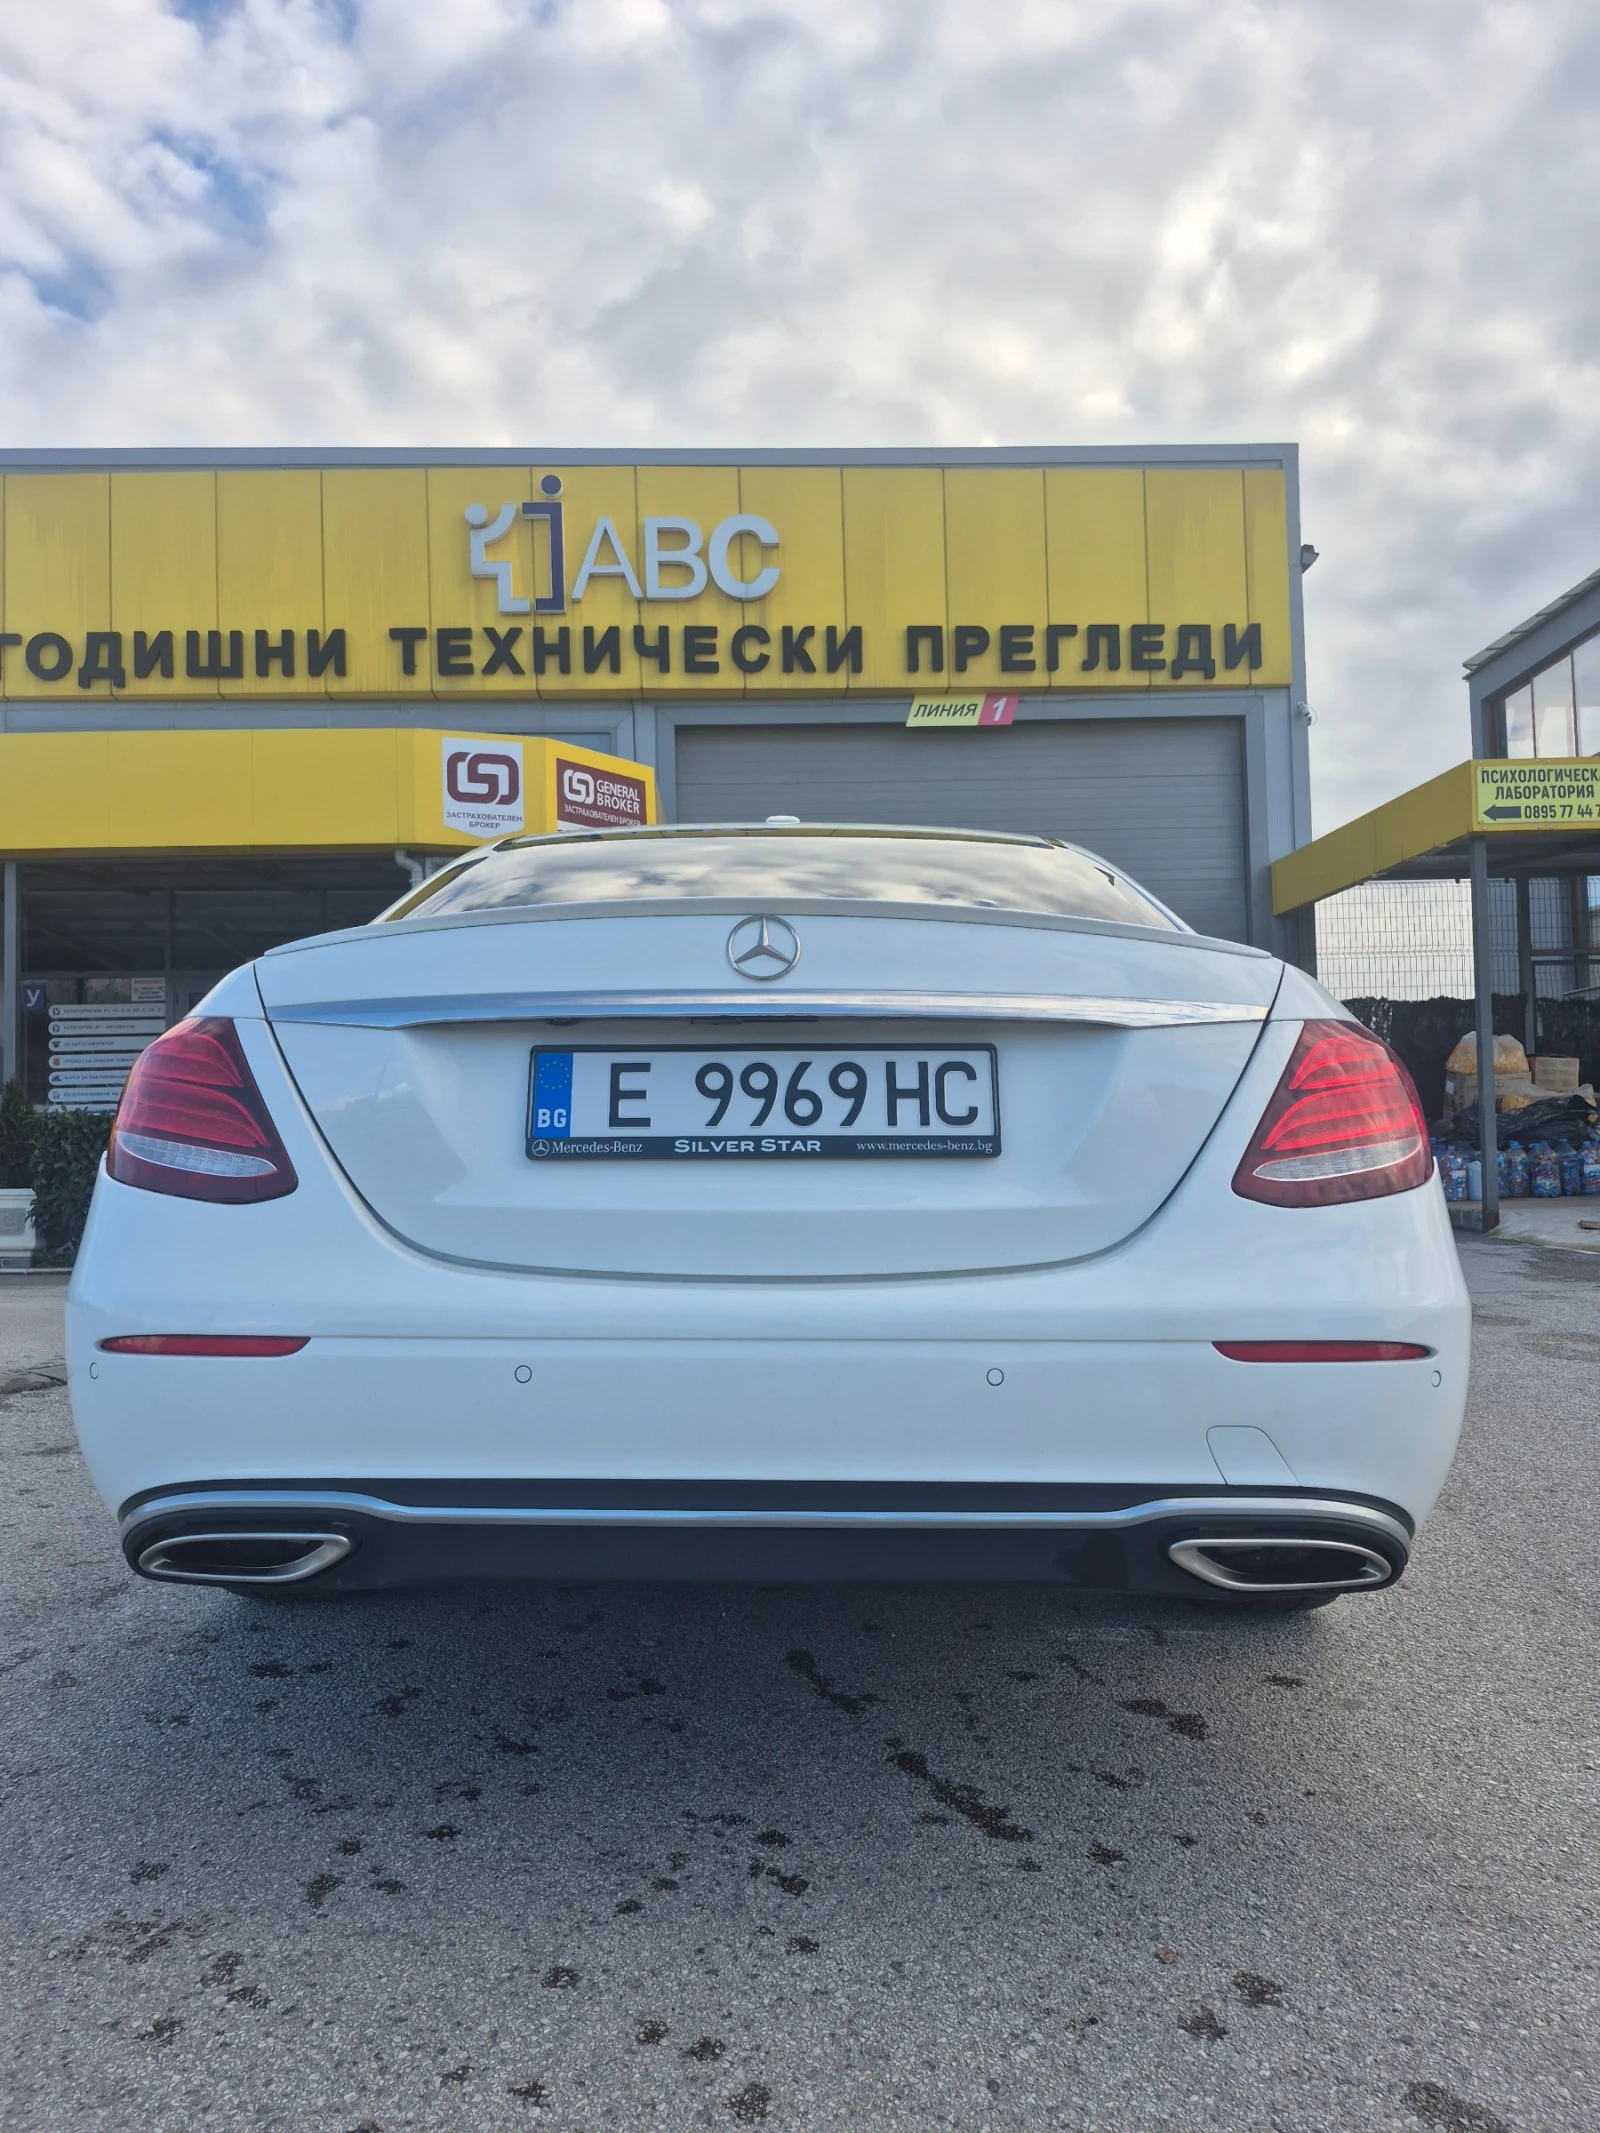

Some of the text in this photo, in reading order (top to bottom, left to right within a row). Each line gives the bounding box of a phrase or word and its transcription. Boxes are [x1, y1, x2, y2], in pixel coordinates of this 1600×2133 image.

[388, 624, 863, 676] ТЕХНИЧЕСКИ
[906, 623, 1262, 679] ПРЕГЛЕДИ
[913, 697, 1007, 721] ЛИНИЯ 1
[1481, 768, 1600, 784] ПСИХОЛОГИЧЕСК
[596, 780, 640, 802] GENERAL
[1495, 784, 1595, 800] ЛАБОРАТОРИЯ
[597, 793, 640, 814] BROKER
[1524, 804, 1556, 819] 0895
[1559, 804, 1573, 818] 77
[1577, 804, 1593, 818] 44
[446, 811, 522, 822] ЗАСТРАХОВАТЕЛЕН
[564, 804, 619, 823] ЗАСТРАХОВАТЕЛЕН
[469, 821, 500, 829] БРОКЕР
[609, 1061, 979, 1127] E 9969 HC
[537, 1108, 567, 1128] BG
[552, 1141, 643, 1154] Mercedes-Benz
[856, 1139, 993, 1154] www.mercedes-benz.bg
